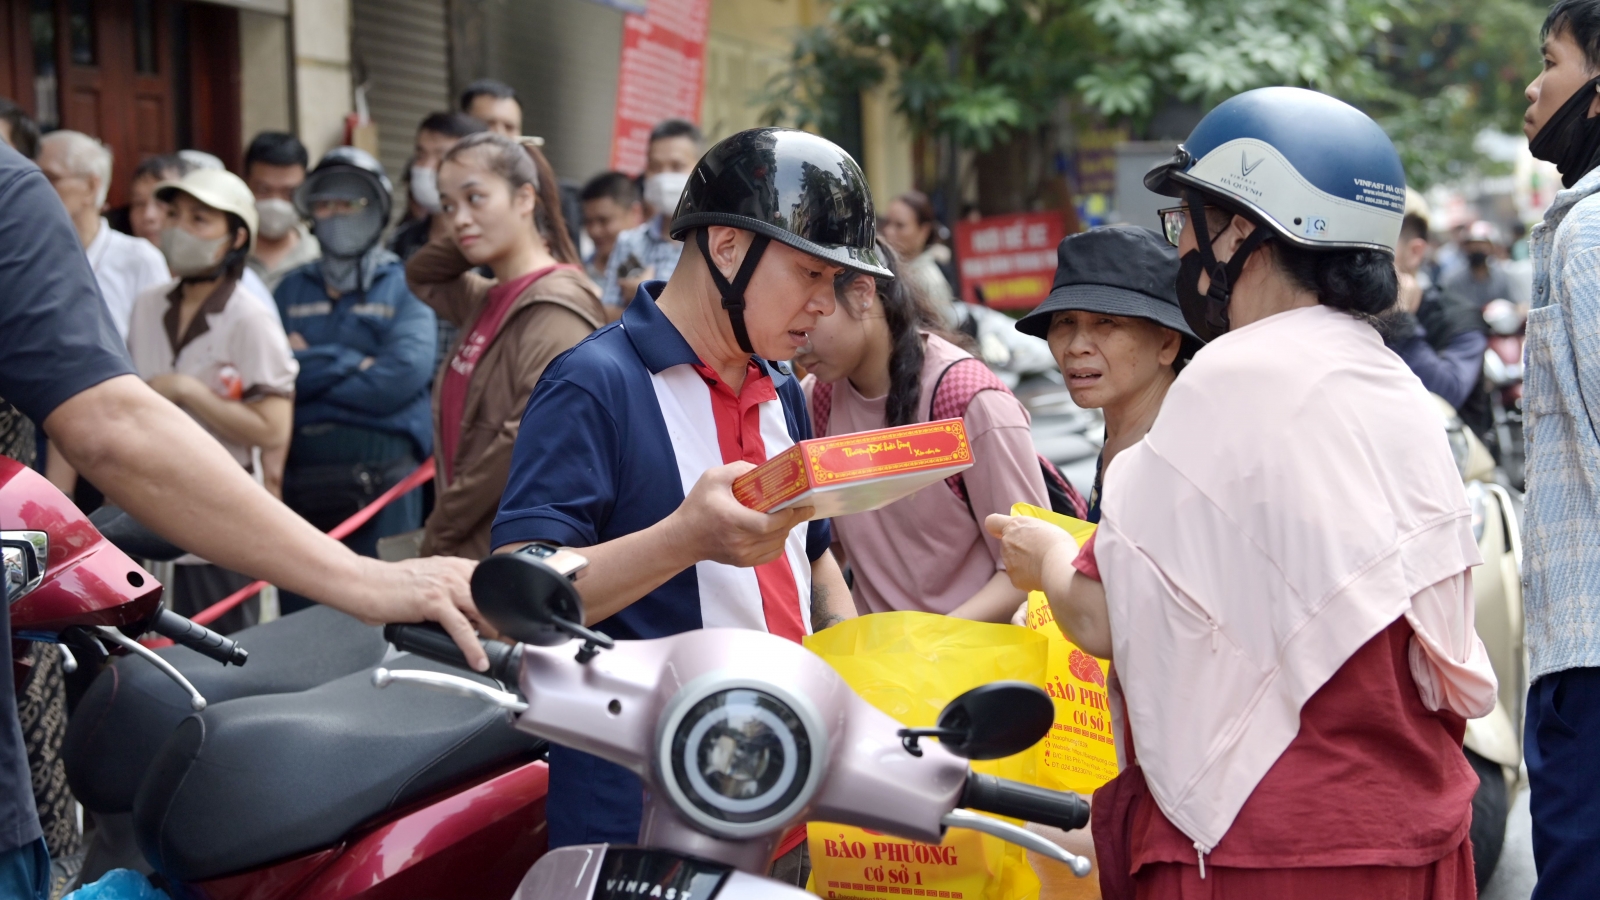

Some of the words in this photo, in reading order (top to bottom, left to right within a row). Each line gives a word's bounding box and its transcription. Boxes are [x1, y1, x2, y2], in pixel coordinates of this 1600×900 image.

[1354, 178, 1385, 190] VINFAST
[1045, 675, 1076, 702] BẢO
[1073, 710, 1088, 727] CƠ
[1090, 711, 1105, 732] SỞ
[824, 833, 867, 859] BẢO
[872, 841, 958, 866] PHƯƠNG
[864, 865, 885, 882] CƠ
[888, 863, 910, 885] SỞ
[914, 871, 924, 885] 1
[606, 879, 692, 900] VINFAST
